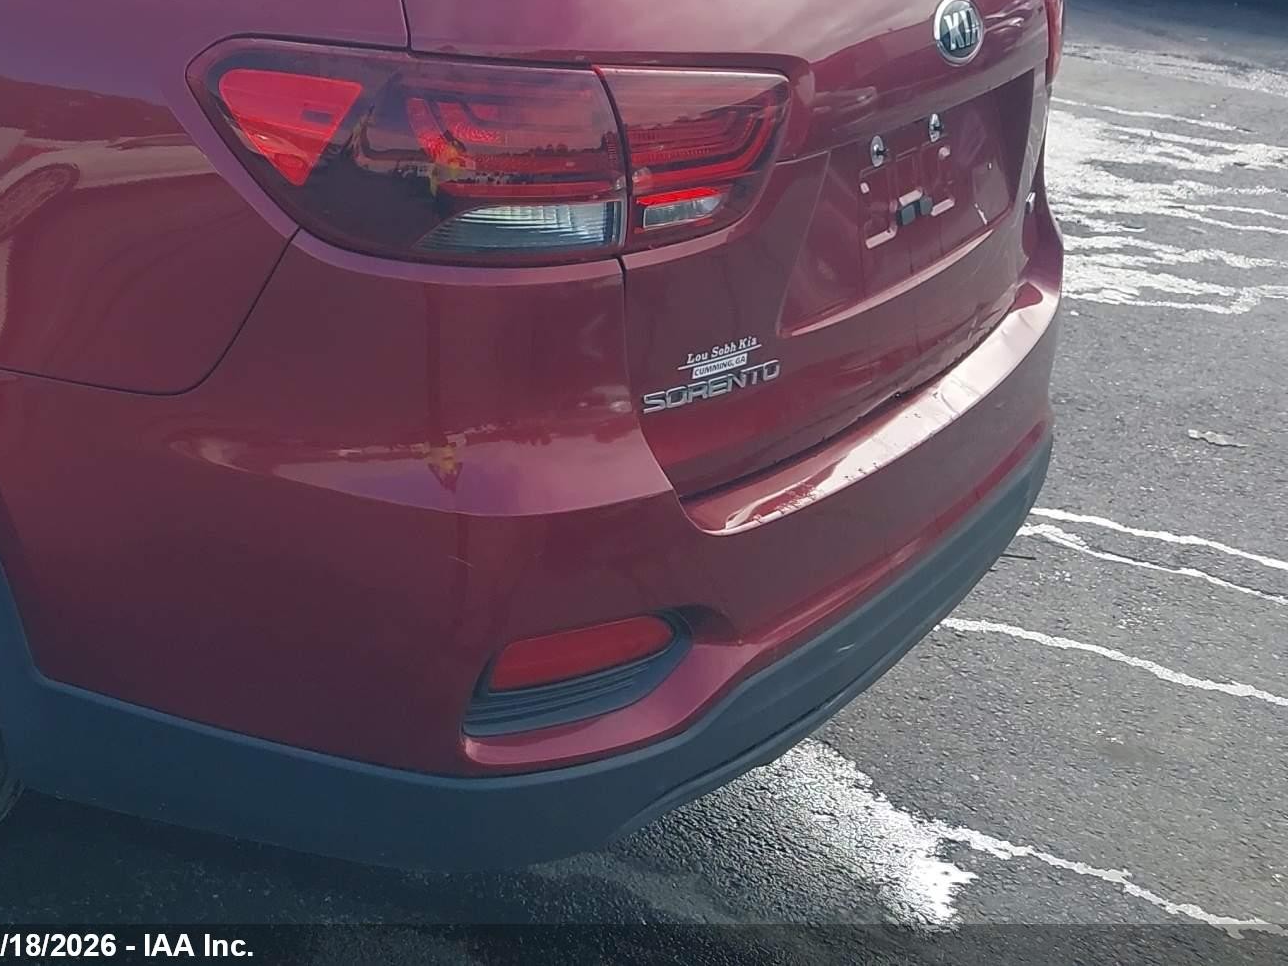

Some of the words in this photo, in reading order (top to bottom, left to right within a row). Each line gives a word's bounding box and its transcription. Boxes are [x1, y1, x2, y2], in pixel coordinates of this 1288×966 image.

[943, 7, 980, 50] KIA
[686, 352, 708, 364] Lou
[711, 341, 737, 358] Sobh
[735, 355, 746, 365] GA
[643, 359, 781, 414] SORENTO
